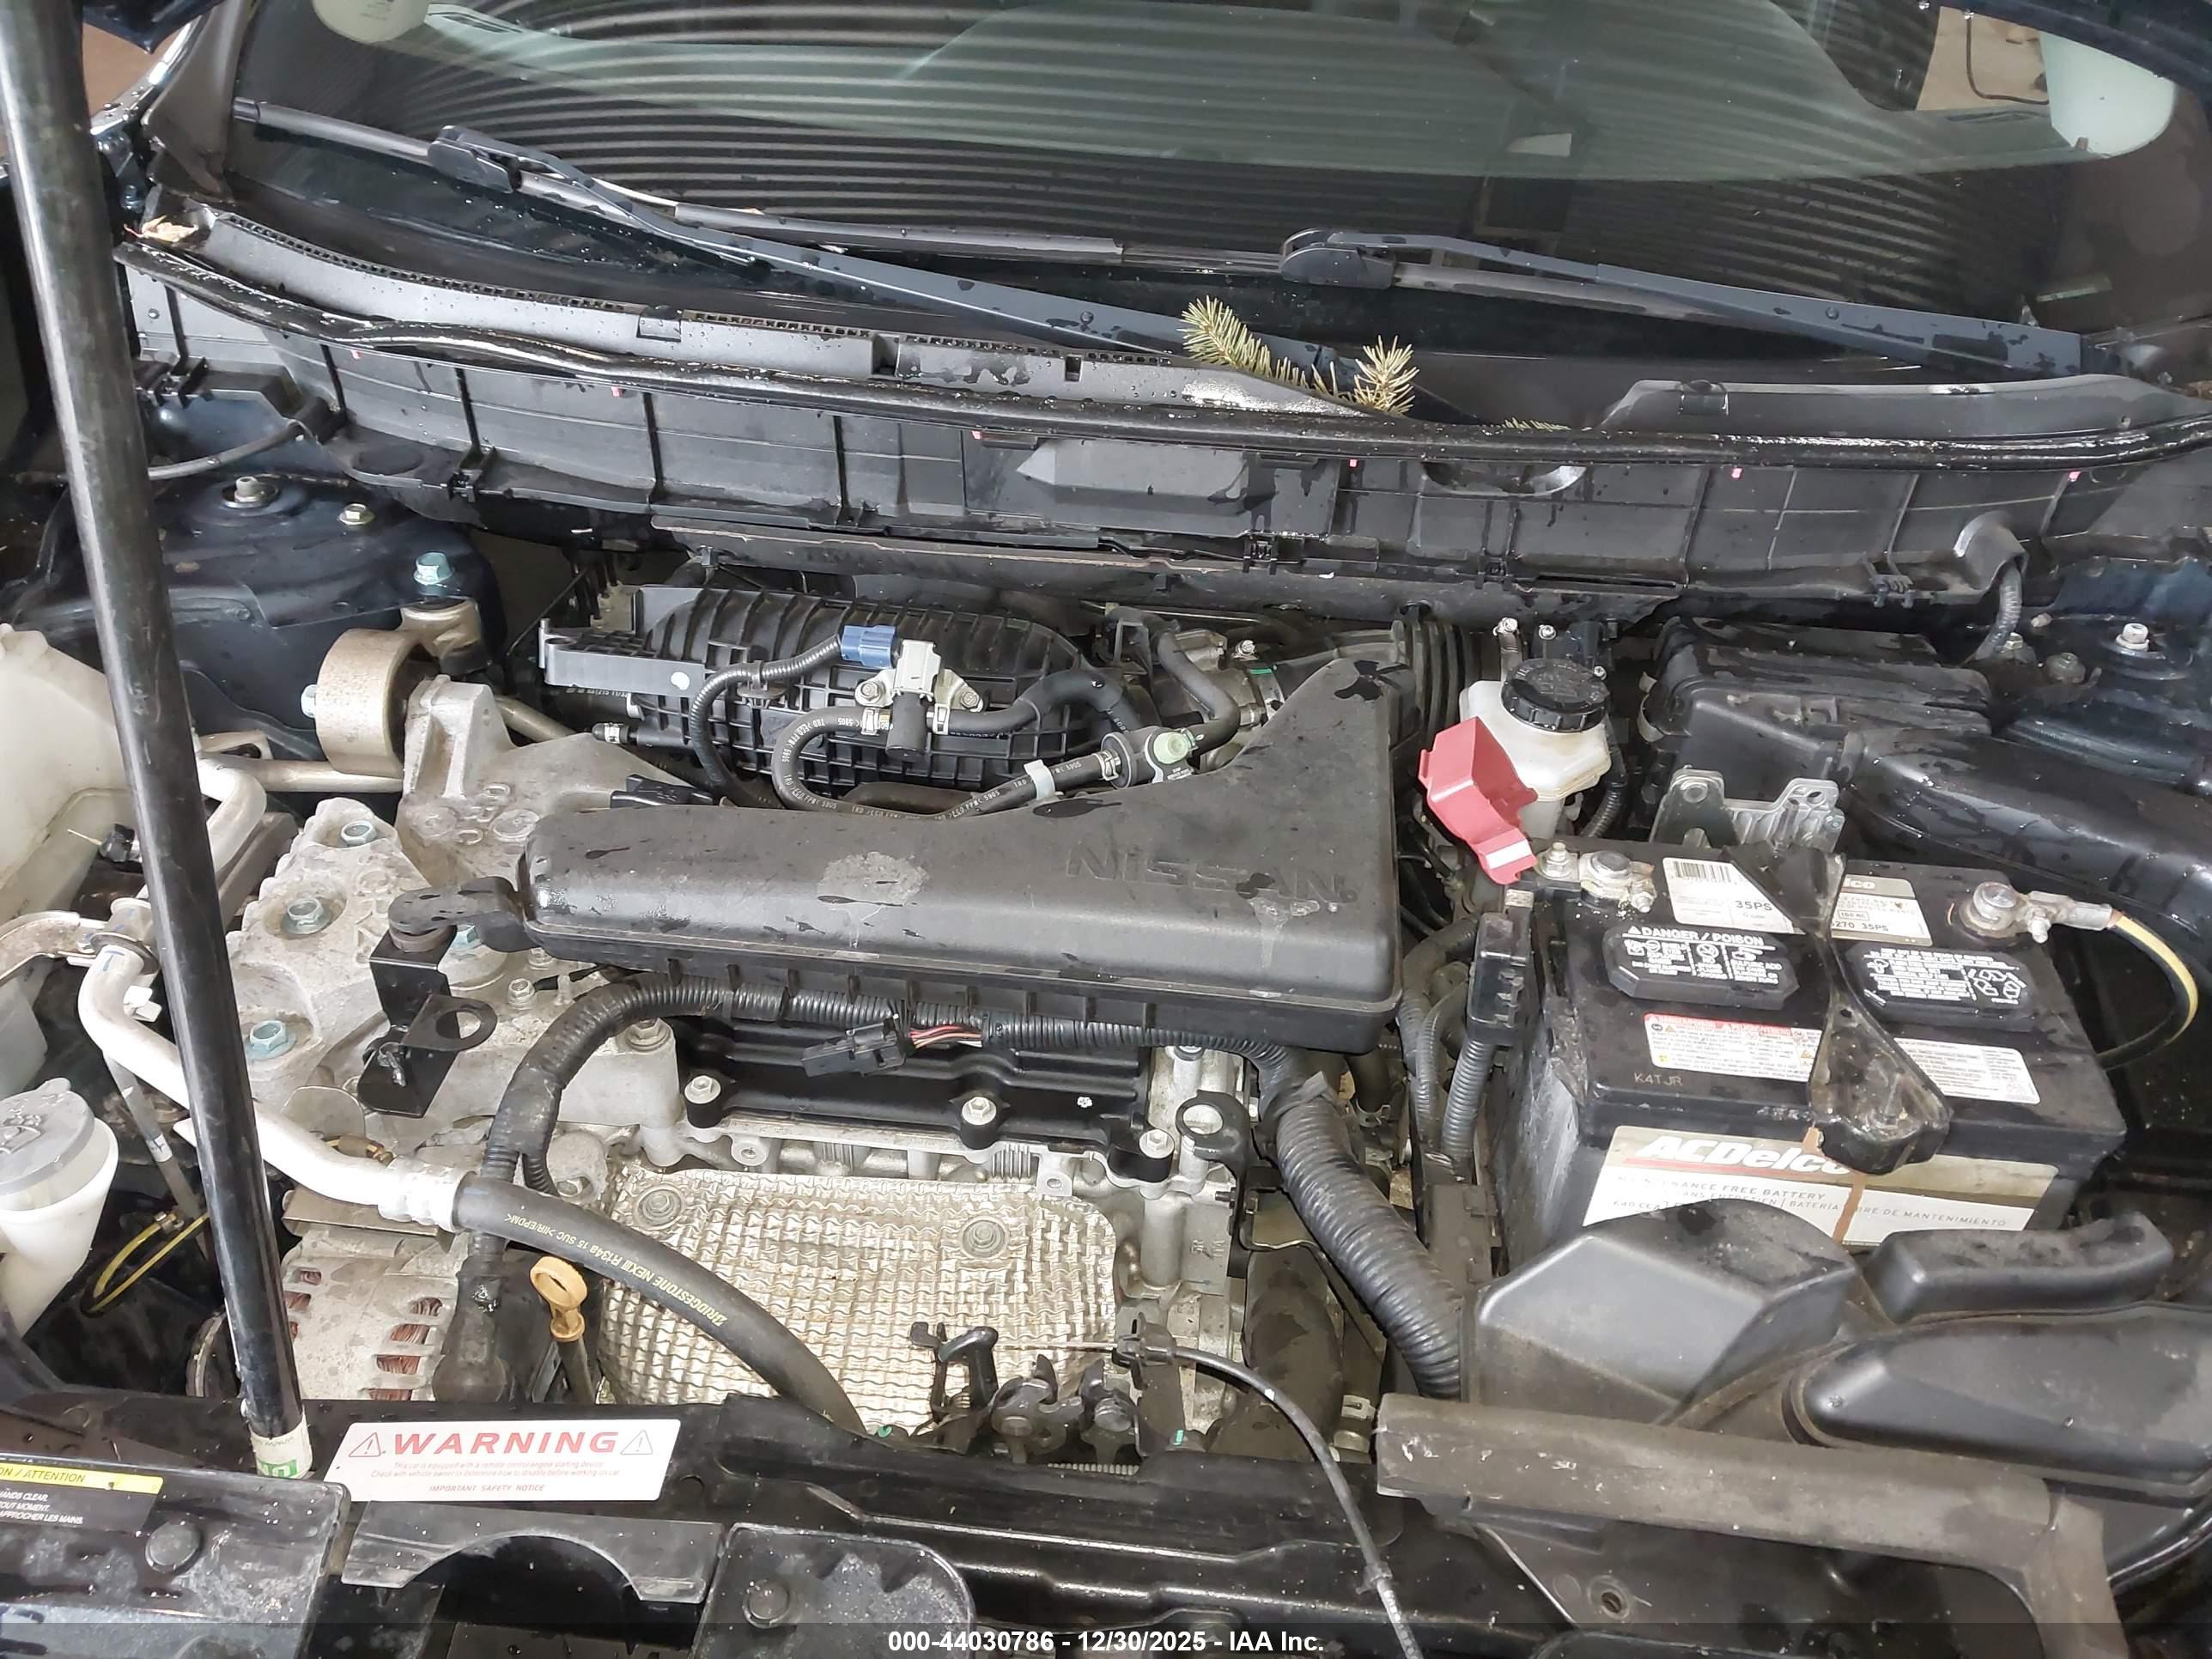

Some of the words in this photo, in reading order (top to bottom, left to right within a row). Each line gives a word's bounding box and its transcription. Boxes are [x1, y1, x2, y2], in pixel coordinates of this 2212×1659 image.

[1066, 842, 1346, 902] NISSAN
[1735, 899, 1773, 911] 35PS
[1862, 921, 1889, 932] 35PS
[1641, 927, 1699, 941] DANGER
[1711, 933, 1765, 946] POISON
[1723, 1184, 1758, 1195] FREE
[1762, 1188, 1826, 1200] BATTERY
[1881, 1208, 1899, 1218] DE
[1903, 1210, 2007, 1227] MANTENIMIENTO
[556, 1231, 577, 1246] SUC
[576, 1240, 591, 1250] 15
[589, 1245, 623, 1267] R134a
[652, 1274, 729, 1328] BRIDGESTONE
[394, 1431, 619, 1455] WARNING
[24, 1469, 87, 1484] ATTENTION
[370, 1469, 392, 1478] Check
[43, 1513, 60, 1522] LES
